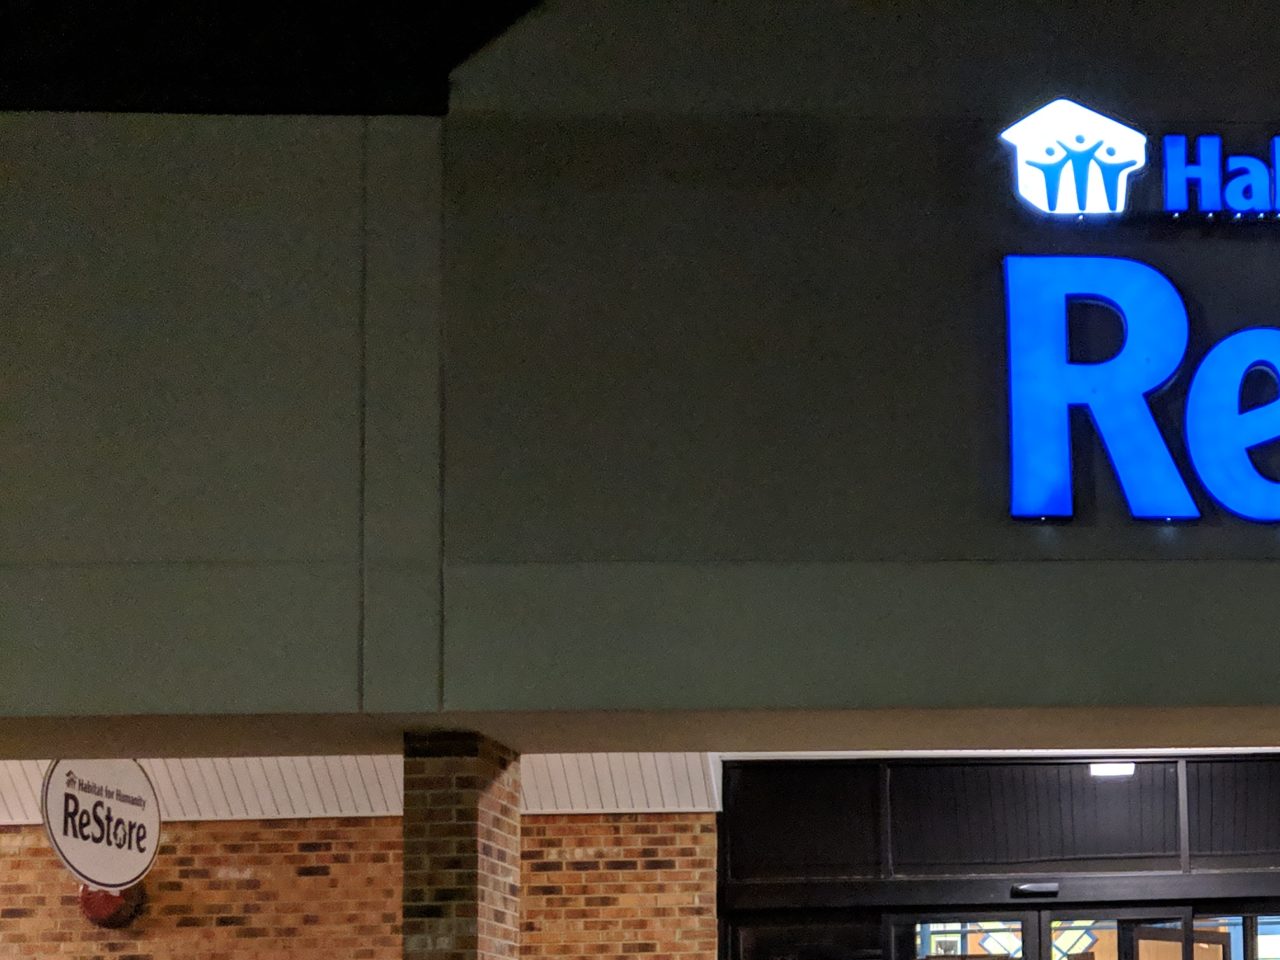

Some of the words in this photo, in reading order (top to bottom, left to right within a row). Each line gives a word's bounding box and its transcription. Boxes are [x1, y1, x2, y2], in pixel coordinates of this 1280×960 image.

[78, 778, 104, 797] Habitat
[105, 785, 115, 800] for
[116, 788, 146, 811] Humanity
[63, 792, 147, 854] ReStore
